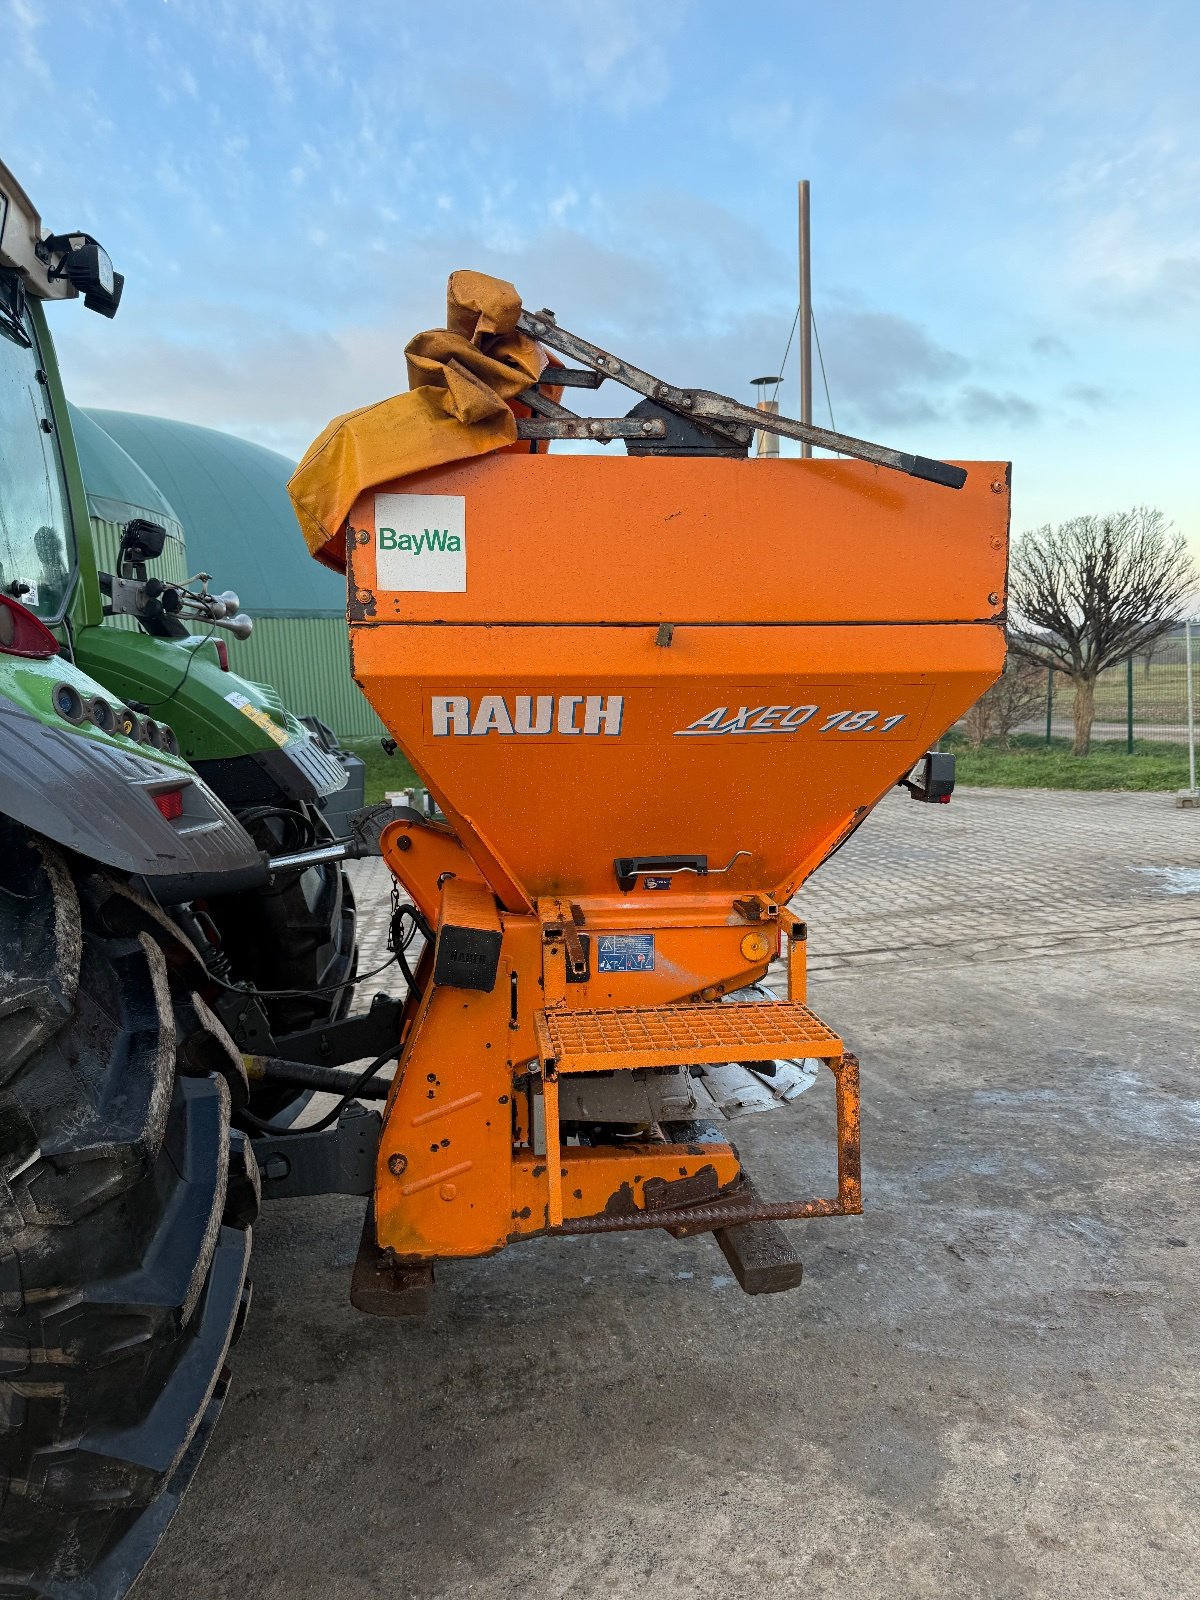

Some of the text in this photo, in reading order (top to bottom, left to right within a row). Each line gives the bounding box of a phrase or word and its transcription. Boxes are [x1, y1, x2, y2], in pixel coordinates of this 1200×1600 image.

[379, 527, 461, 556] BayWa
[431, 695, 624, 736] RAUCH
[676, 704, 907, 735] AXEO 18.1
